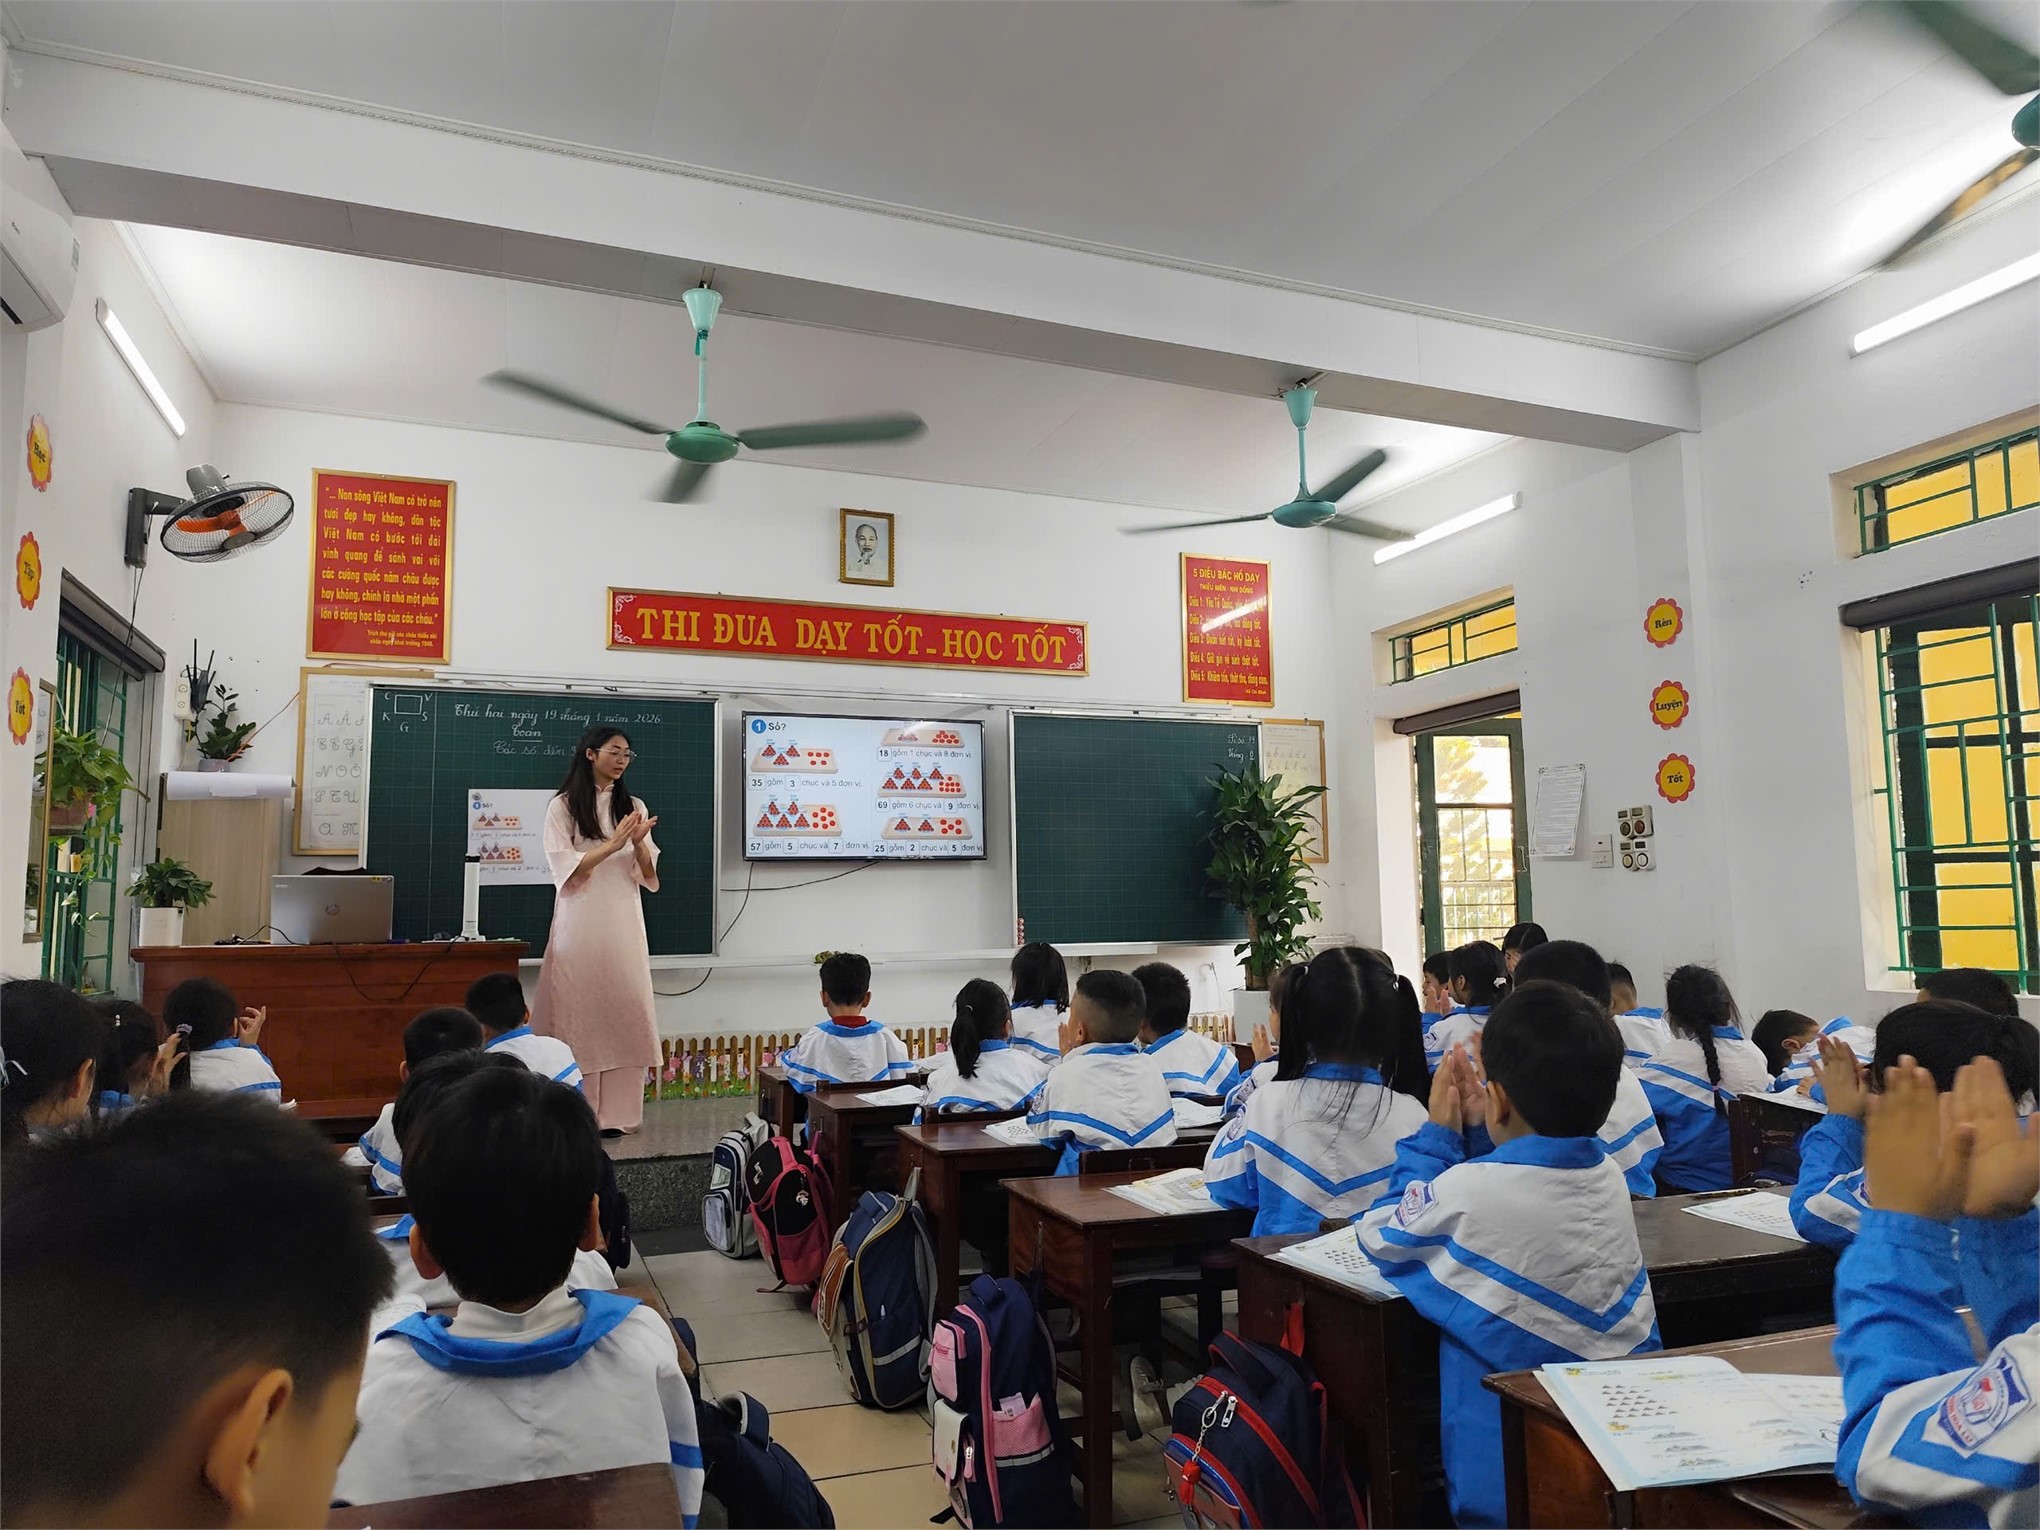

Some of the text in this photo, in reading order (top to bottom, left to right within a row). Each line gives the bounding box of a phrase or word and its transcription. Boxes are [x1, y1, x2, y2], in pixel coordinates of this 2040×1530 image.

[338, 488, 352, 500] Non
[354, 490, 371, 504] sông
[373, 491, 387, 507] Việt
[389, 493, 405, 505] Nam
[407, 496, 415, 506] có
[417, 493, 427, 507] trở
[429, 496, 441, 508] nên
[324, 508, 441, 530] tươi đẹp hay không, dân tộc
[323, 527, 440, 546] Việt Nam có bước tới đài
[323, 547, 440, 566] vinh quang để sánh vai với
[322, 567, 439, 588] các cường quốc năm châu được
[1193, 569, 1198, 577] 5
[1218, 568, 1232, 580] BÁC
[1245, 573, 1260, 585] DẠY
[321, 588, 334, 600] hay
[362, 589, 381, 602] chính
[383, 590, 390, 602] là
[406, 594, 420, 607] một
[321, 607, 331, 619] lớn
[340, 609, 357, 623] công
[359, 609, 372, 626] học
[374, 611, 385, 626] tập
[388, 608, 400, 623] của
[402, 611, 414, 624] các
[637, 608, 700, 642] THI
[713, 613, 777, 646] ĐUA
[796, 618, 851, 654] DẠY
[864, 614, 923, 654] TỐT
[943, 629, 1003, 664] HỌC
[1012, 624, 1066, 663] TỐT
[385, 692, 433, 701] C V
[1656, 699, 1682, 711] Luyện
[383, 712, 428, 721] K S
[455, 704, 479, 717] Thứ
[486, 704, 504, 718] hai
[511, 710, 538, 726] ngày
[545, 710, 557, 720] 19
[604, 714, 628, 723] năm
[634, 713, 660, 723] 2026
[400, 721, 409, 733] G
[512, 724, 541, 737] Toán
[768, 721, 786, 730] Số?
[522, 745, 539, 754] số
[893, 749, 907, 757] gồm
[752, 779, 763, 787] 35
[767, 778, 783, 787] gồm
[1667, 772, 1683, 783] Tốt
[892, 800, 907, 809] gồm
[750, 843, 760, 851] 57
[765, 842, 781, 850] gồm
[800, 842, 818, 850] chục
[889, 843, 904, 852] gồm
